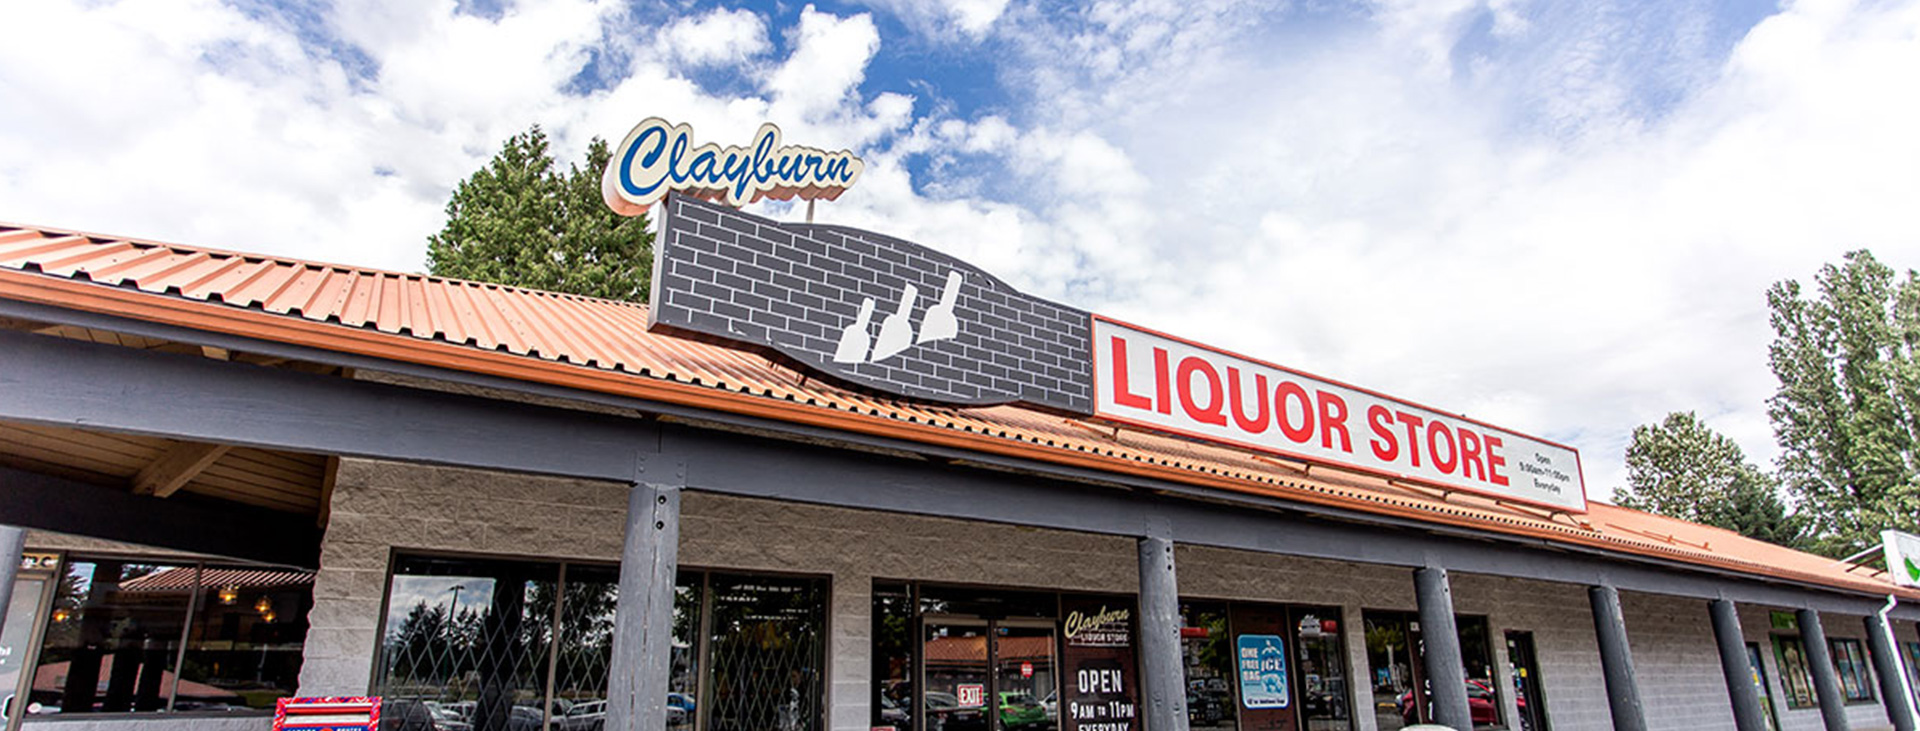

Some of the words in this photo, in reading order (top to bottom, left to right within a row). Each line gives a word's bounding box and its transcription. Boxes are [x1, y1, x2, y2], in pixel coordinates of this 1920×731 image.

[619, 126, 853, 200] Clayburn
[1112, 336, 1352, 453] LIQUOR
[1367, 404, 1510, 487] STORE
[1064, 605, 1129, 638] Clayburn
[1080, 633, 1105, 642] LIQUOR
[1106, 633, 1128, 642] STORE
[1241, 647, 1258, 658] ONE
[1261, 657, 1283, 672] ICE
[1078, 669, 1123, 693] OPEN
[1243, 670, 1260, 681] BAG
[961, 687, 980, 704] EXIT
